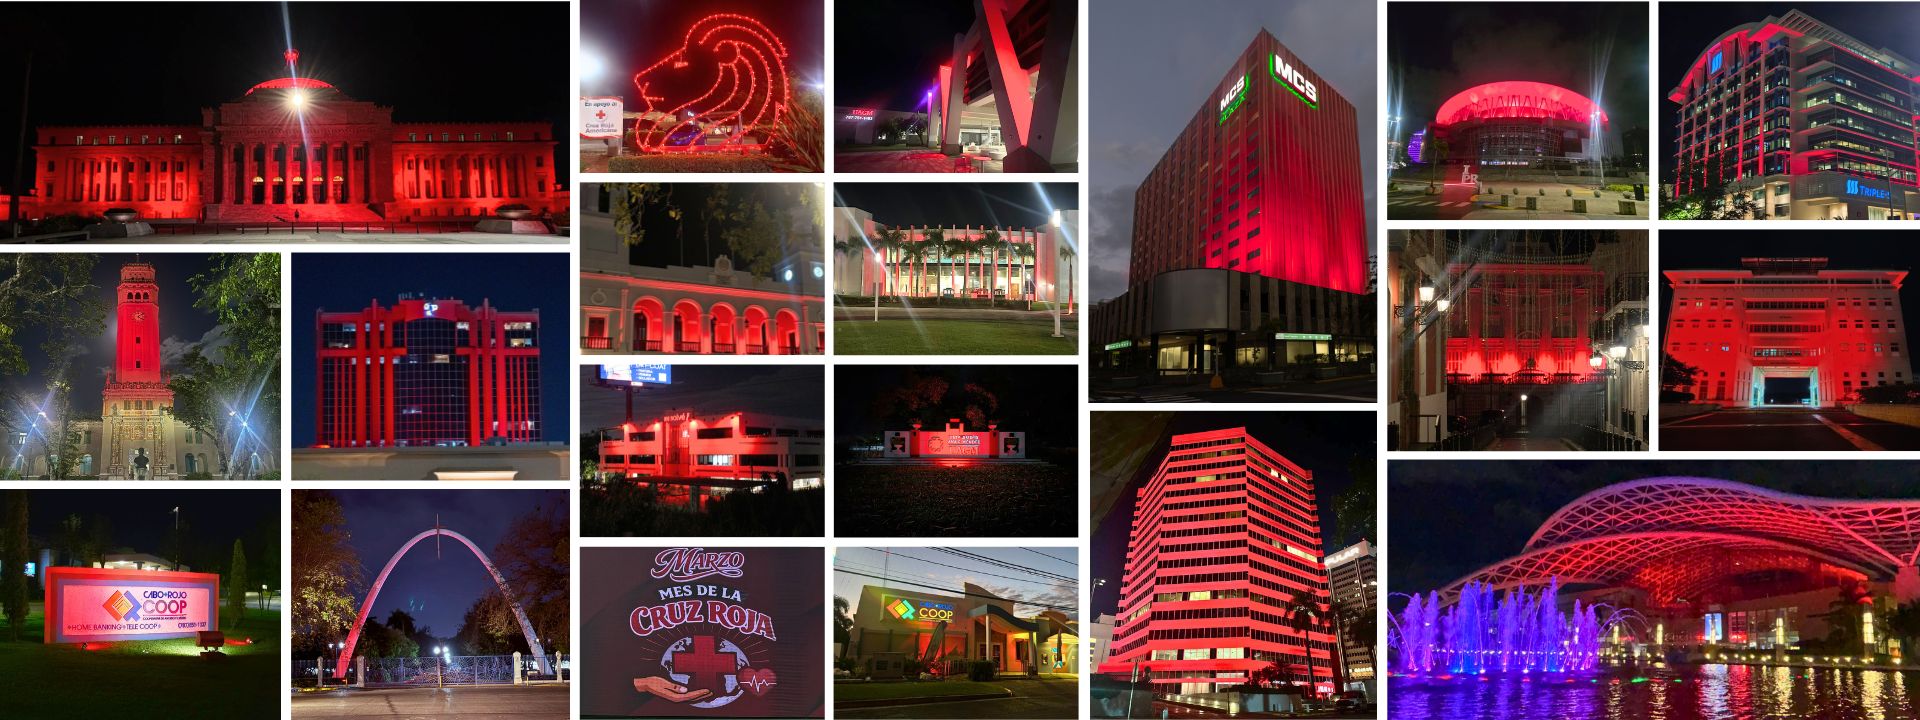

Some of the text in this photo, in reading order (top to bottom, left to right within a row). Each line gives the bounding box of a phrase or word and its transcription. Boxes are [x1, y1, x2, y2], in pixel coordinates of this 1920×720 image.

[1275, 54, 1317, 103] MCS
[1220, 75, 1245, 112] MCS
[651, 548, 745, 582] MARZO
[143, 590, 187, 599] CABO ROJO
[658, 585, 742, 602] MES DE LA
[143, 599, 187, 614] COOP
[919, 607, 953, 619] COOP
[630, 600, 776, 641] CRUZ ROJA
